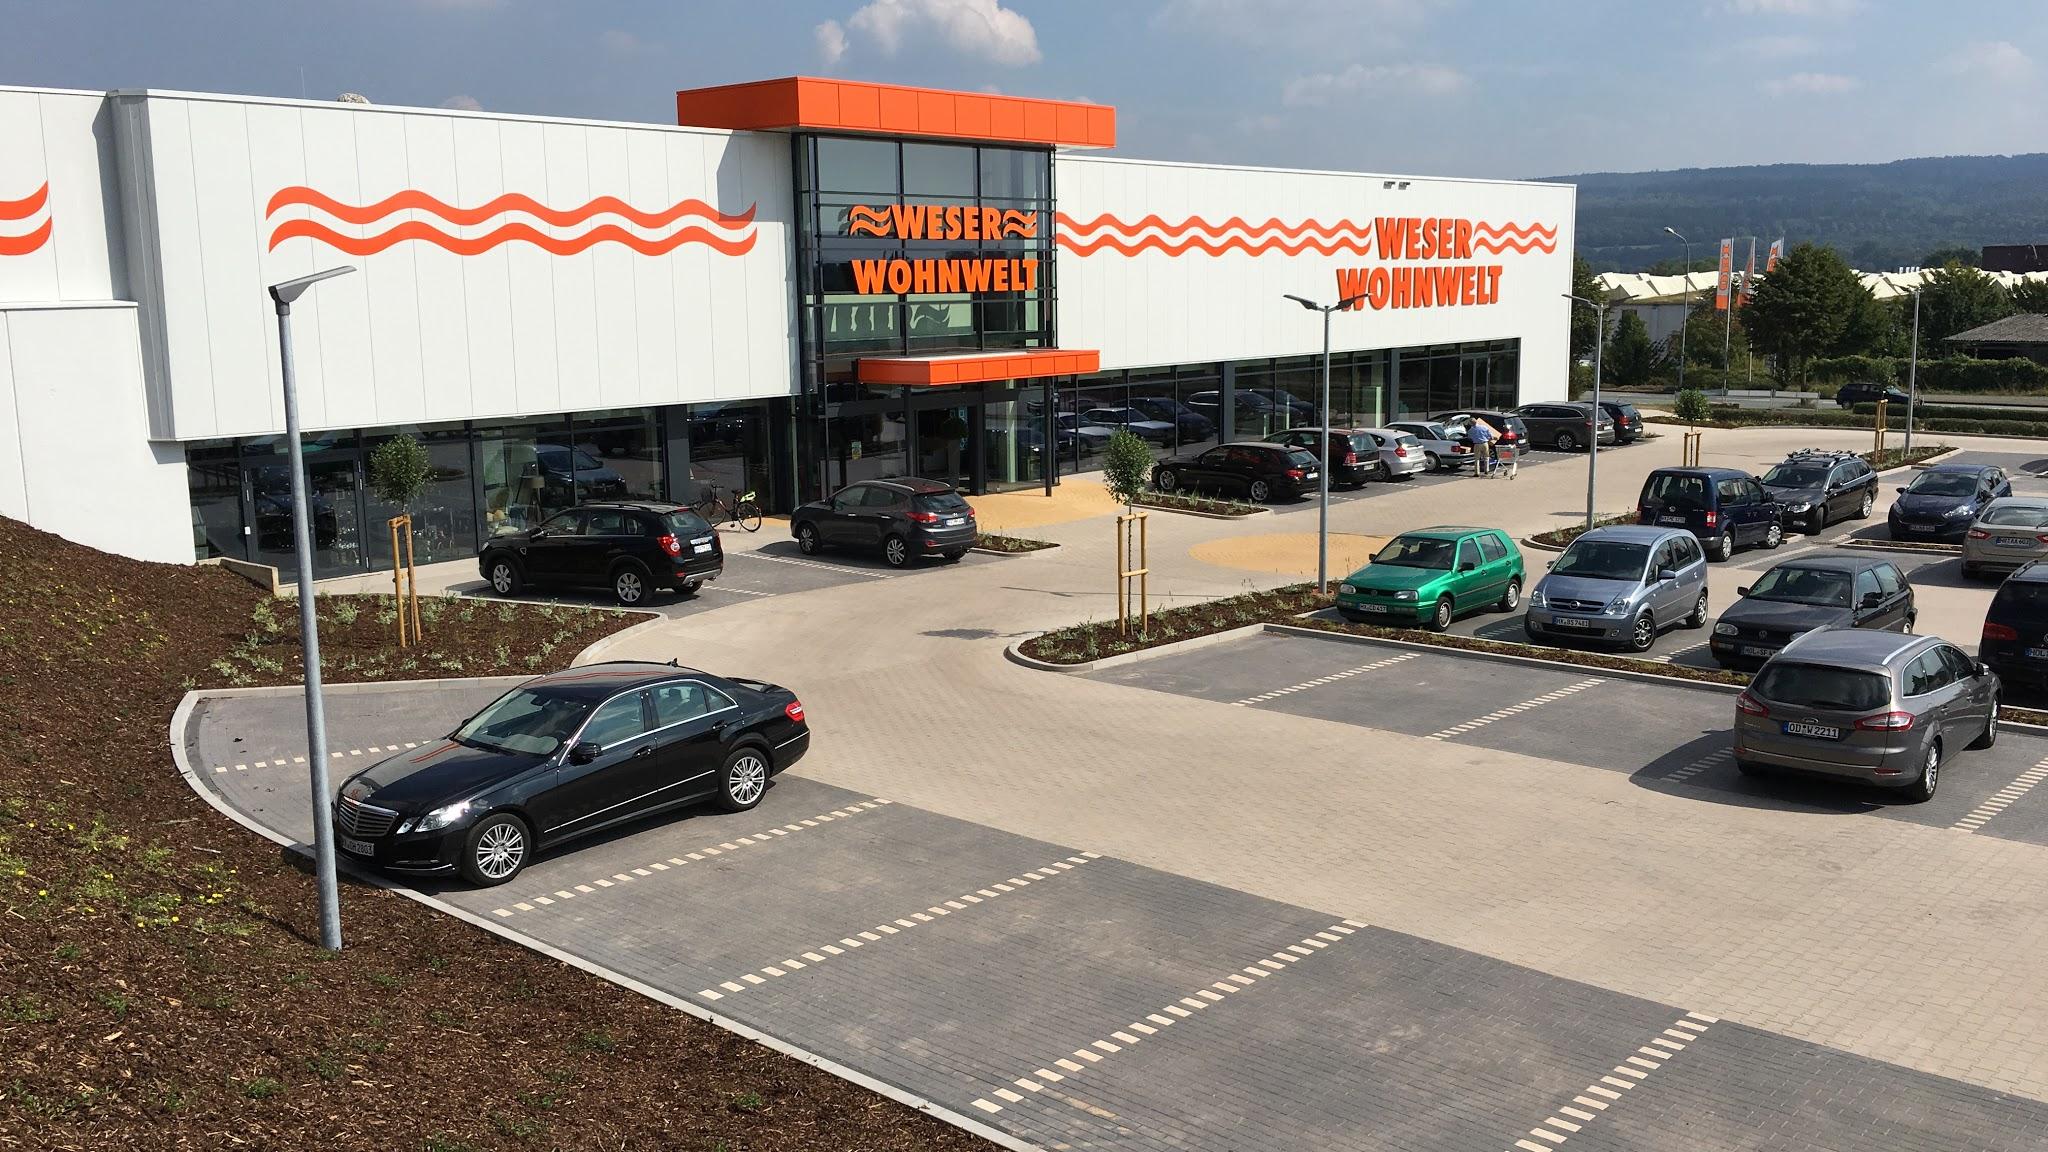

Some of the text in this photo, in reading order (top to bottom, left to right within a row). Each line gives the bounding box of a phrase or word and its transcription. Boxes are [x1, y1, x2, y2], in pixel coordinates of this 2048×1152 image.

[892, 204, 1003, 240] WESER
[1375, 217, 1473, 260] WESER
[852, 258, 1038, 294] WOHNWELT
[1336, 265, 1503, 312] WOHNWELT
